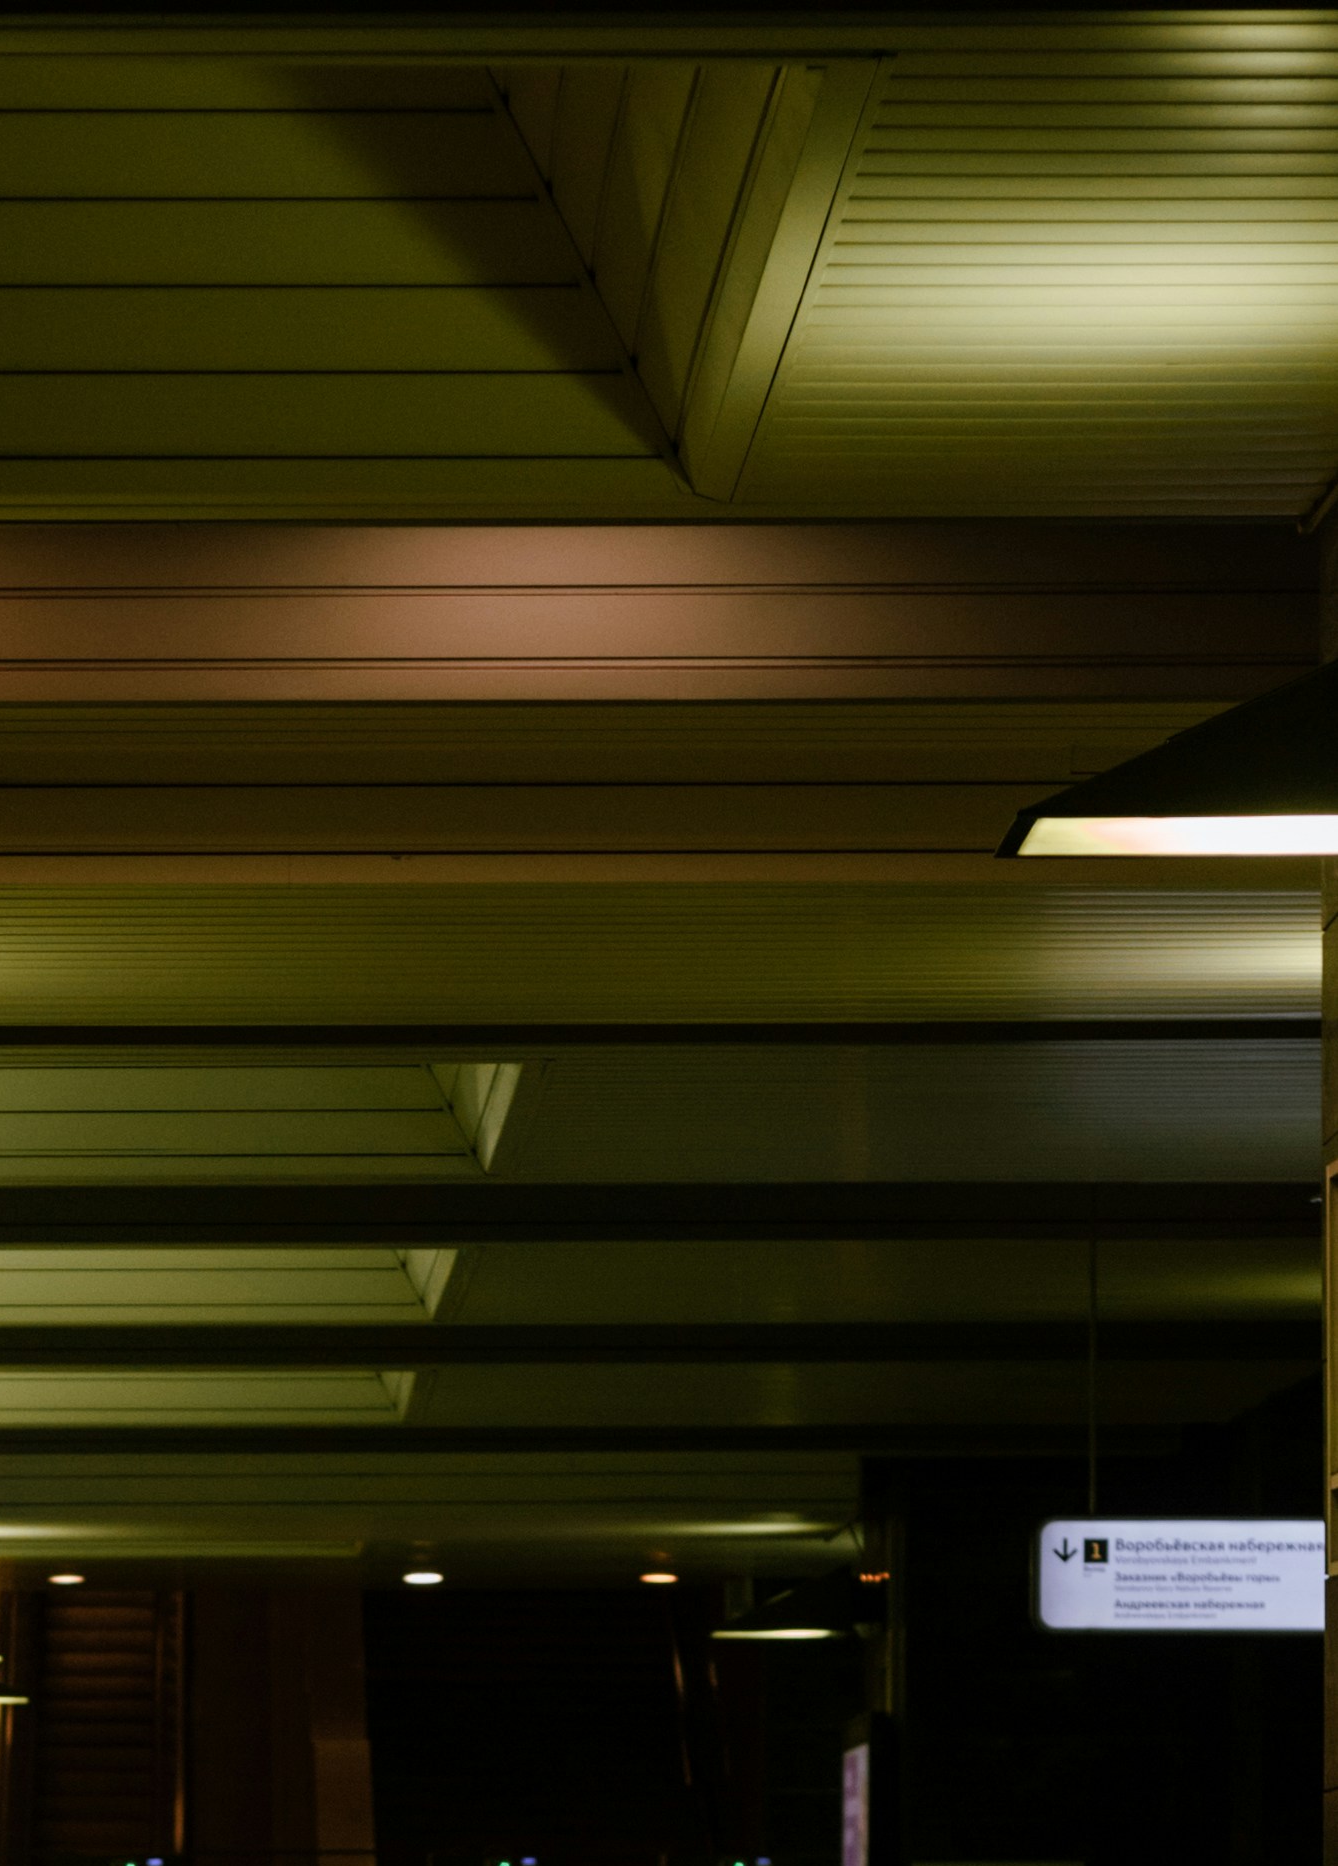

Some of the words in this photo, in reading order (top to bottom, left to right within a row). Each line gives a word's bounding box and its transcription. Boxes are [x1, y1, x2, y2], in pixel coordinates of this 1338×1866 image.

[1091, 1542, 1102, 1559] 1
[1115, 1538, 1225, 1555] Воробьёвская
[1194, 1599, 1265, 1611] набережная
